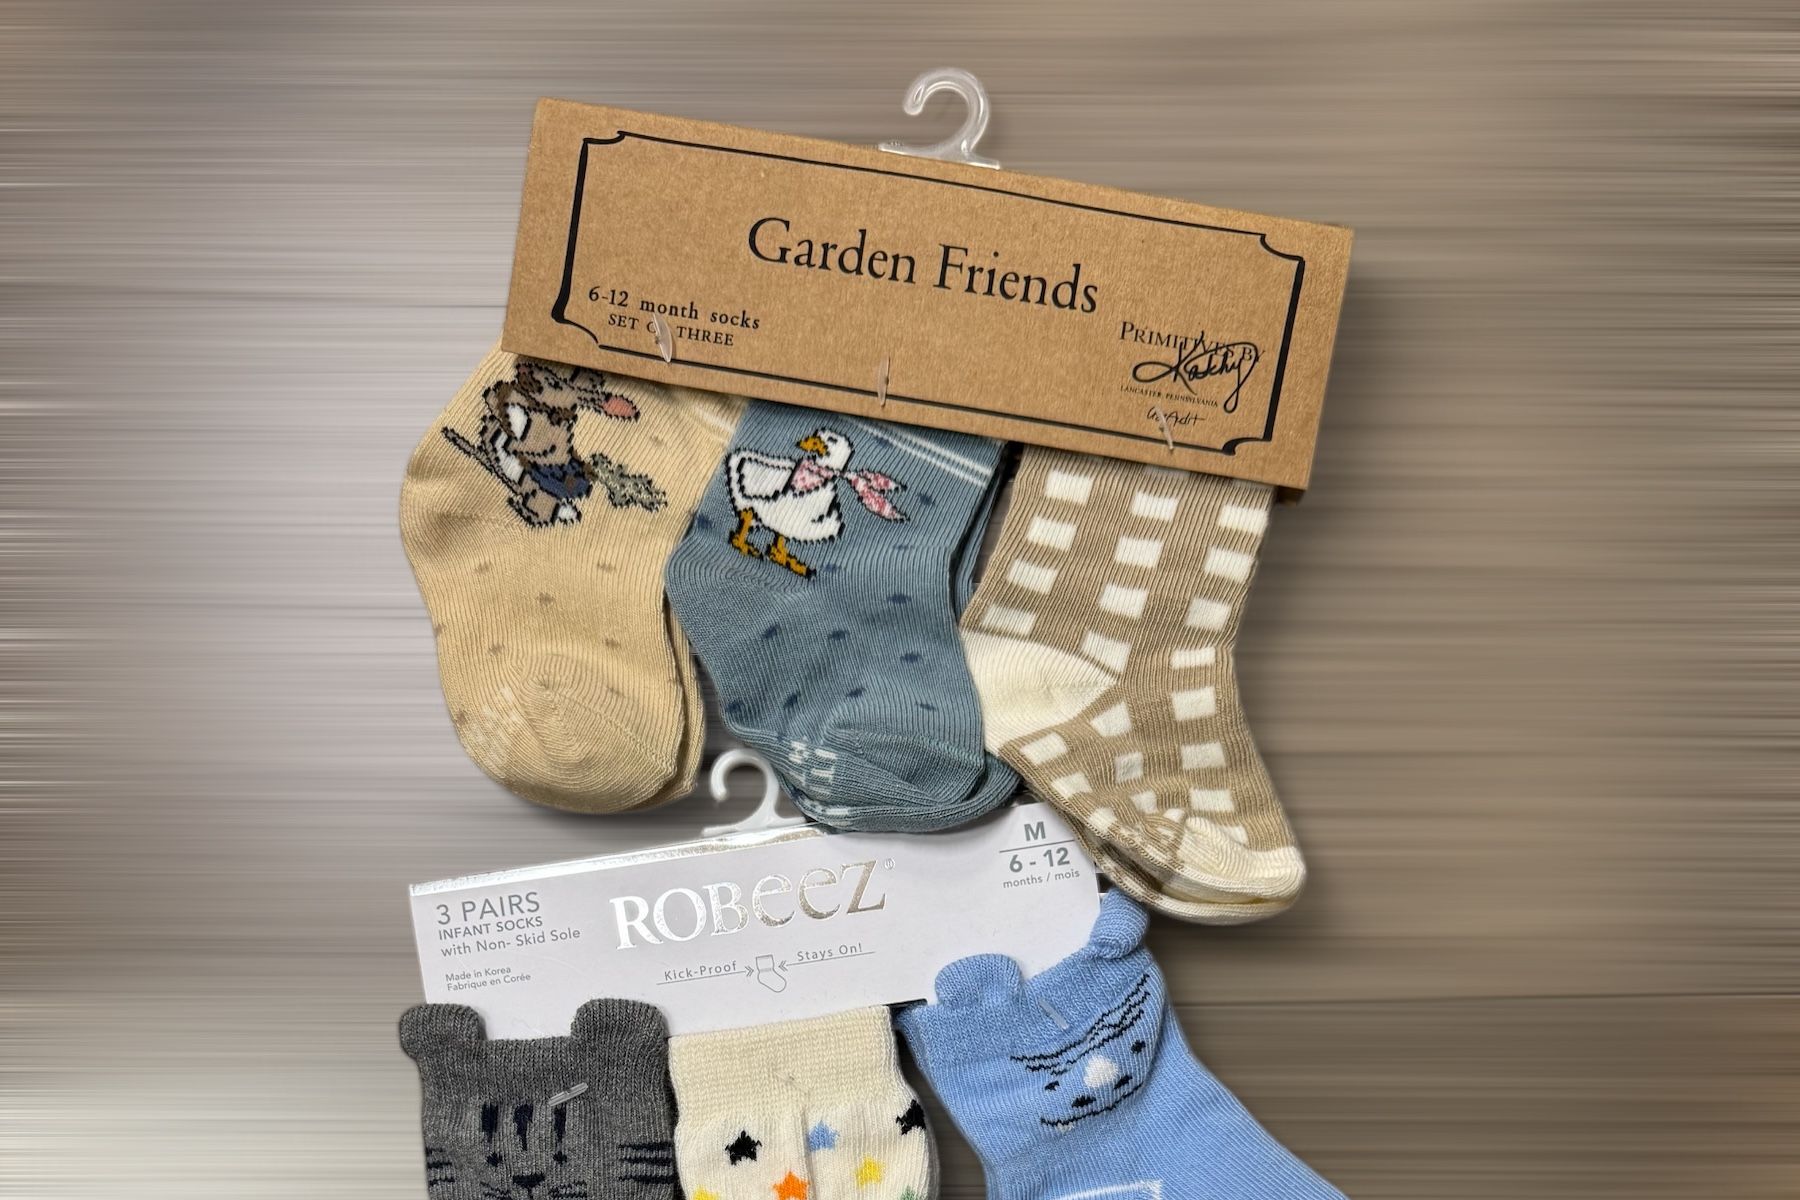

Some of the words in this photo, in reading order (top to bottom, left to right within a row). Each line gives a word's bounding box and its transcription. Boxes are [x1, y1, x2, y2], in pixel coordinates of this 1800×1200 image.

[748, 217, 916, 284] Garden
[933, 243, 1099, 314] Friends
[588, 286, 629, 307] 6-12
[639, 298, 699, 320] month
[710, 310, 760, 330] socks
[608, 313, 639, 331] SET
[676, 326, 734, 346] THREE
[1023, 821, 1046, 841] M
[1003, 875, 1043, 888] months
[1055, 869, 1080, 880] mois
[436, 904, 451, 925] 3
[461, 892, 540, 922] PAIRS
[438, 923, 491, 941] INFANT
[496, 916, 543, 932] SOCKS
[441, 941, 471, 957] with
[516, 931, 546, 947] Skid
[551, 927, 581, 942] Sole
[445, 971, 471, 982] Made
[473, 969, 482, 978] in
[484, 967, 511, 976] Korea
[664, 961, 737, 981] Kick-Proof
[797, 947, 833, 963] Stays
[838, 942, 863, 955] On!
[447, 980, 487, 991] Fabrique
[490, 978, 501, 986] en
